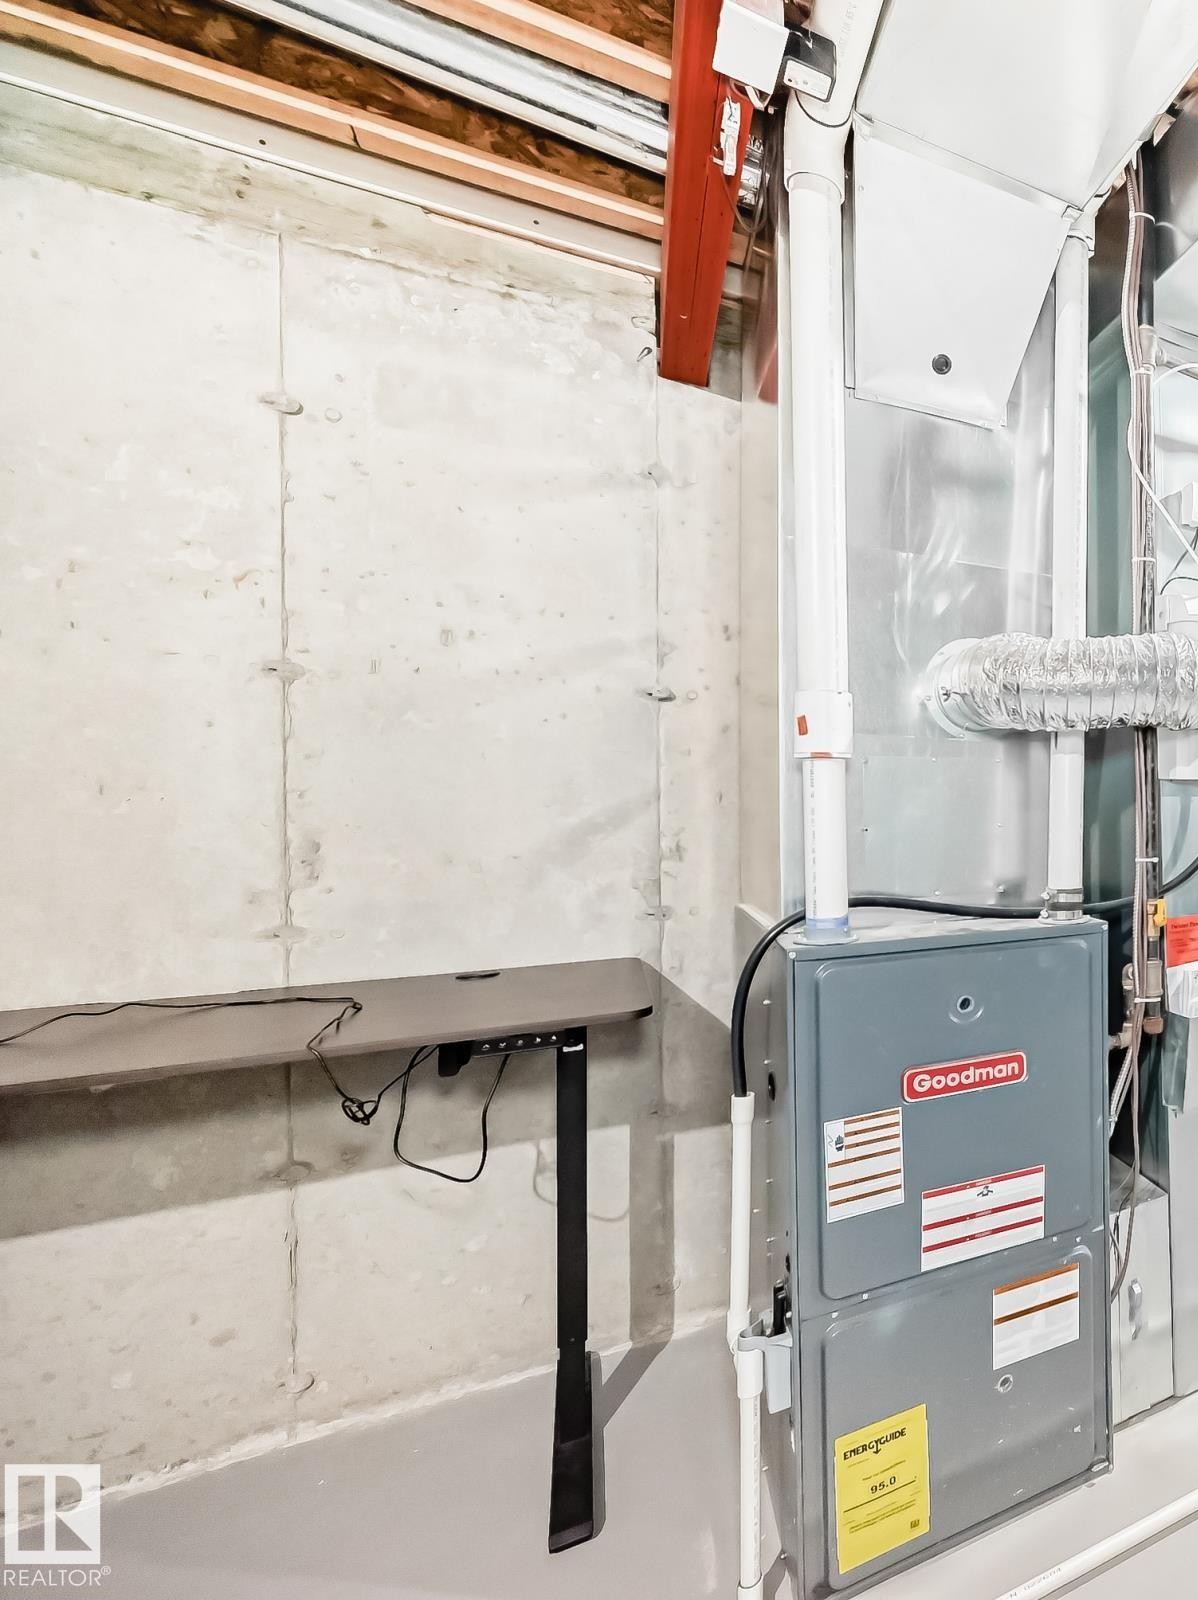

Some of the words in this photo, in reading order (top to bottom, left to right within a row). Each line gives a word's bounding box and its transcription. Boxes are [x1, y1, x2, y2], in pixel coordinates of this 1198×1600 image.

[913, 1061, 1019, 1094] Goodman
[843, 1427, 907, 1461] ENERGYGUIDE
[870, 1475, 896, 1495] 95.0
